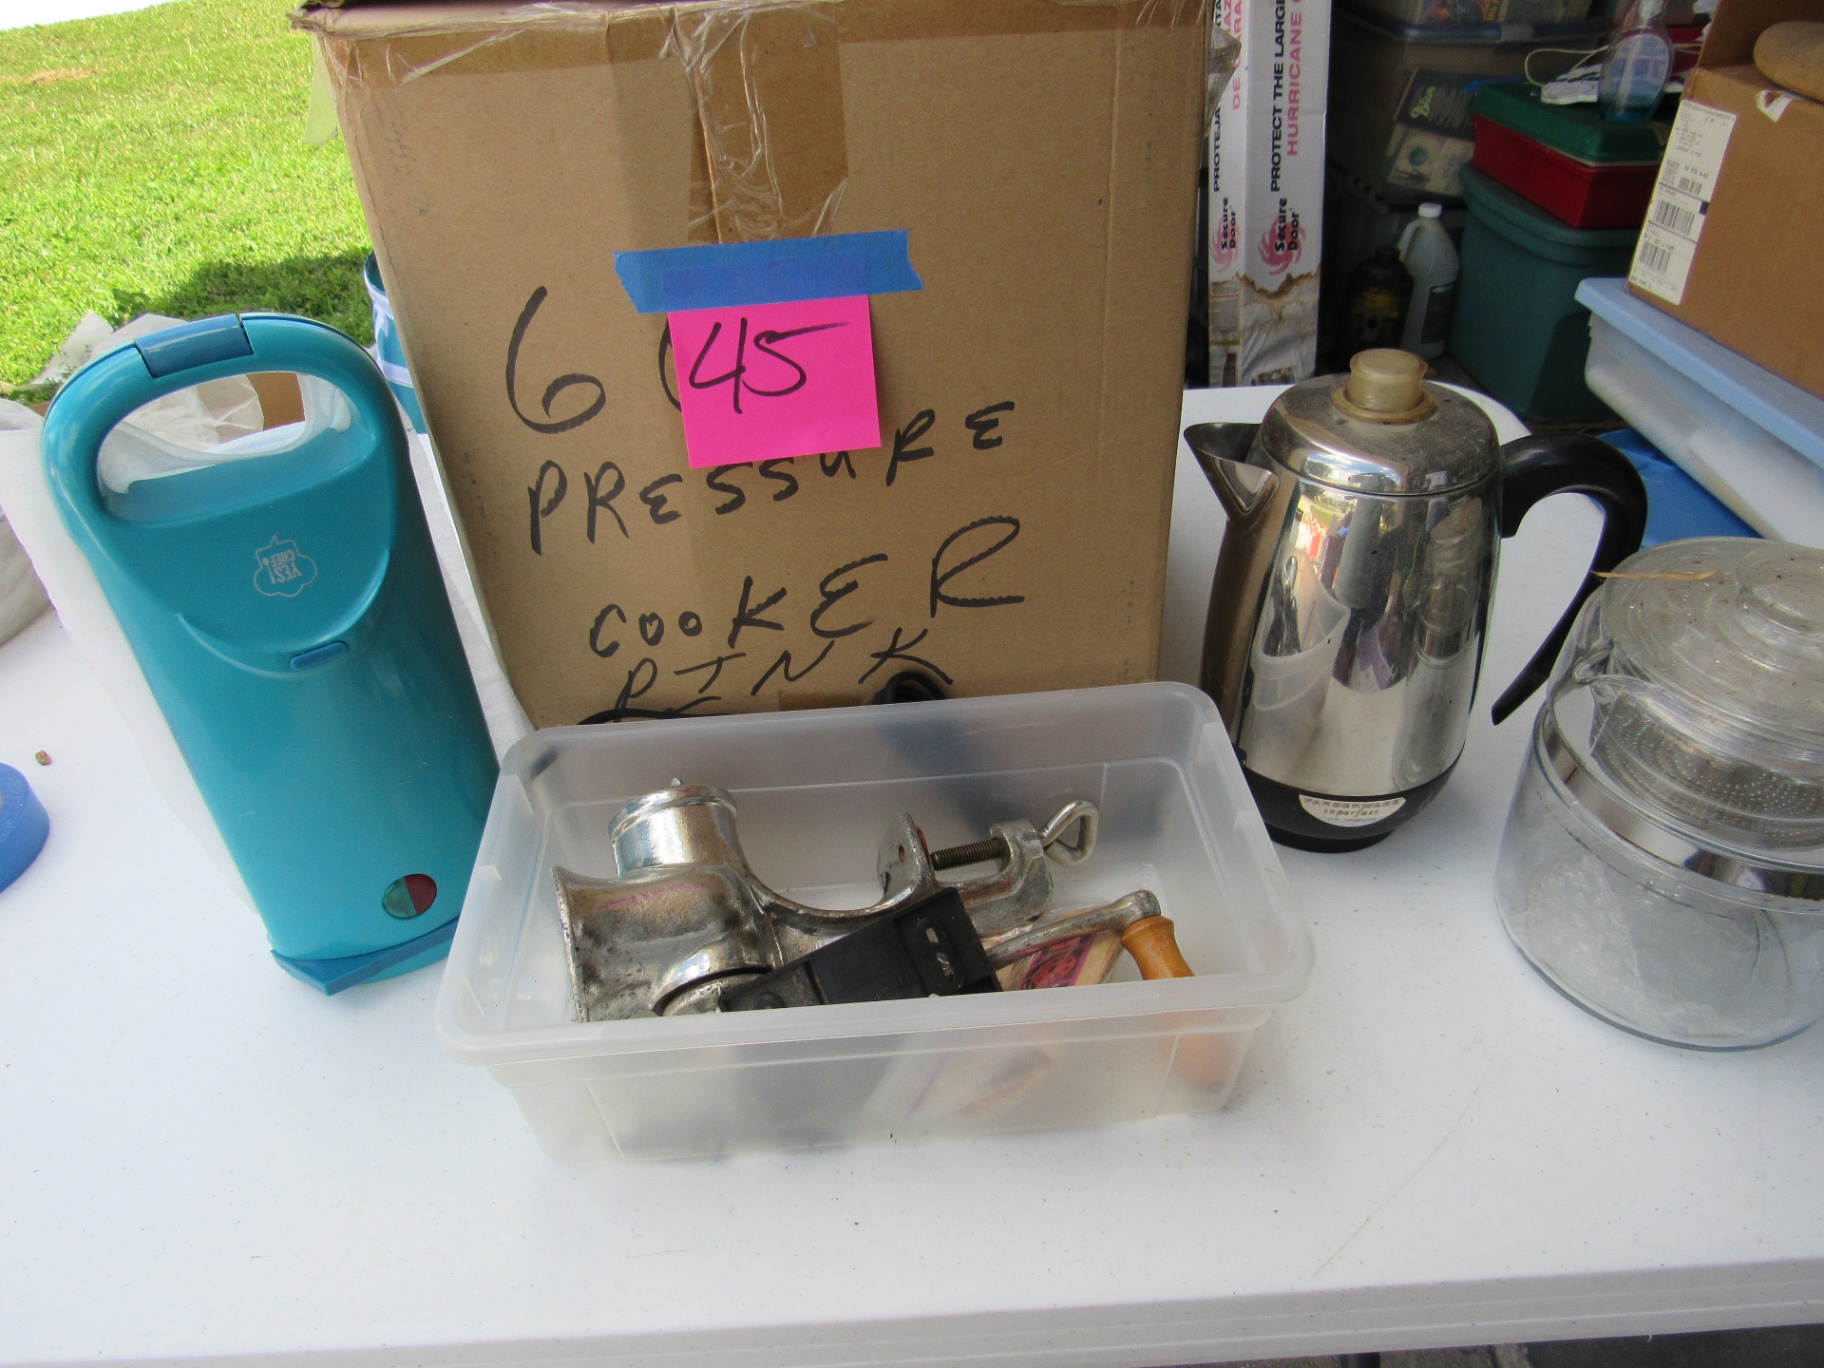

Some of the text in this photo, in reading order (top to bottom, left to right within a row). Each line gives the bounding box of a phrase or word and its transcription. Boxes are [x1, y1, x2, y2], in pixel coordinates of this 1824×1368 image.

[1232, 78, 1241, 110] DE
[1273, 63, 1284, 100] THE
[1287, 12, 1302, 156] HURRICANE
[1213, 107, 1221, 192] PROTEJA
[1271, 105, 1284, 192] PROTECT
[1221, 197, 1229, 250] Secure
[1275, 197, 1288, 252] Secure
[1287, 211, 1300, 251] Door
[689, 316, 850, 414] 45
[527, 400, 1016, 556] PRESSURE
[588, 515, 1026, 659] COOKER
